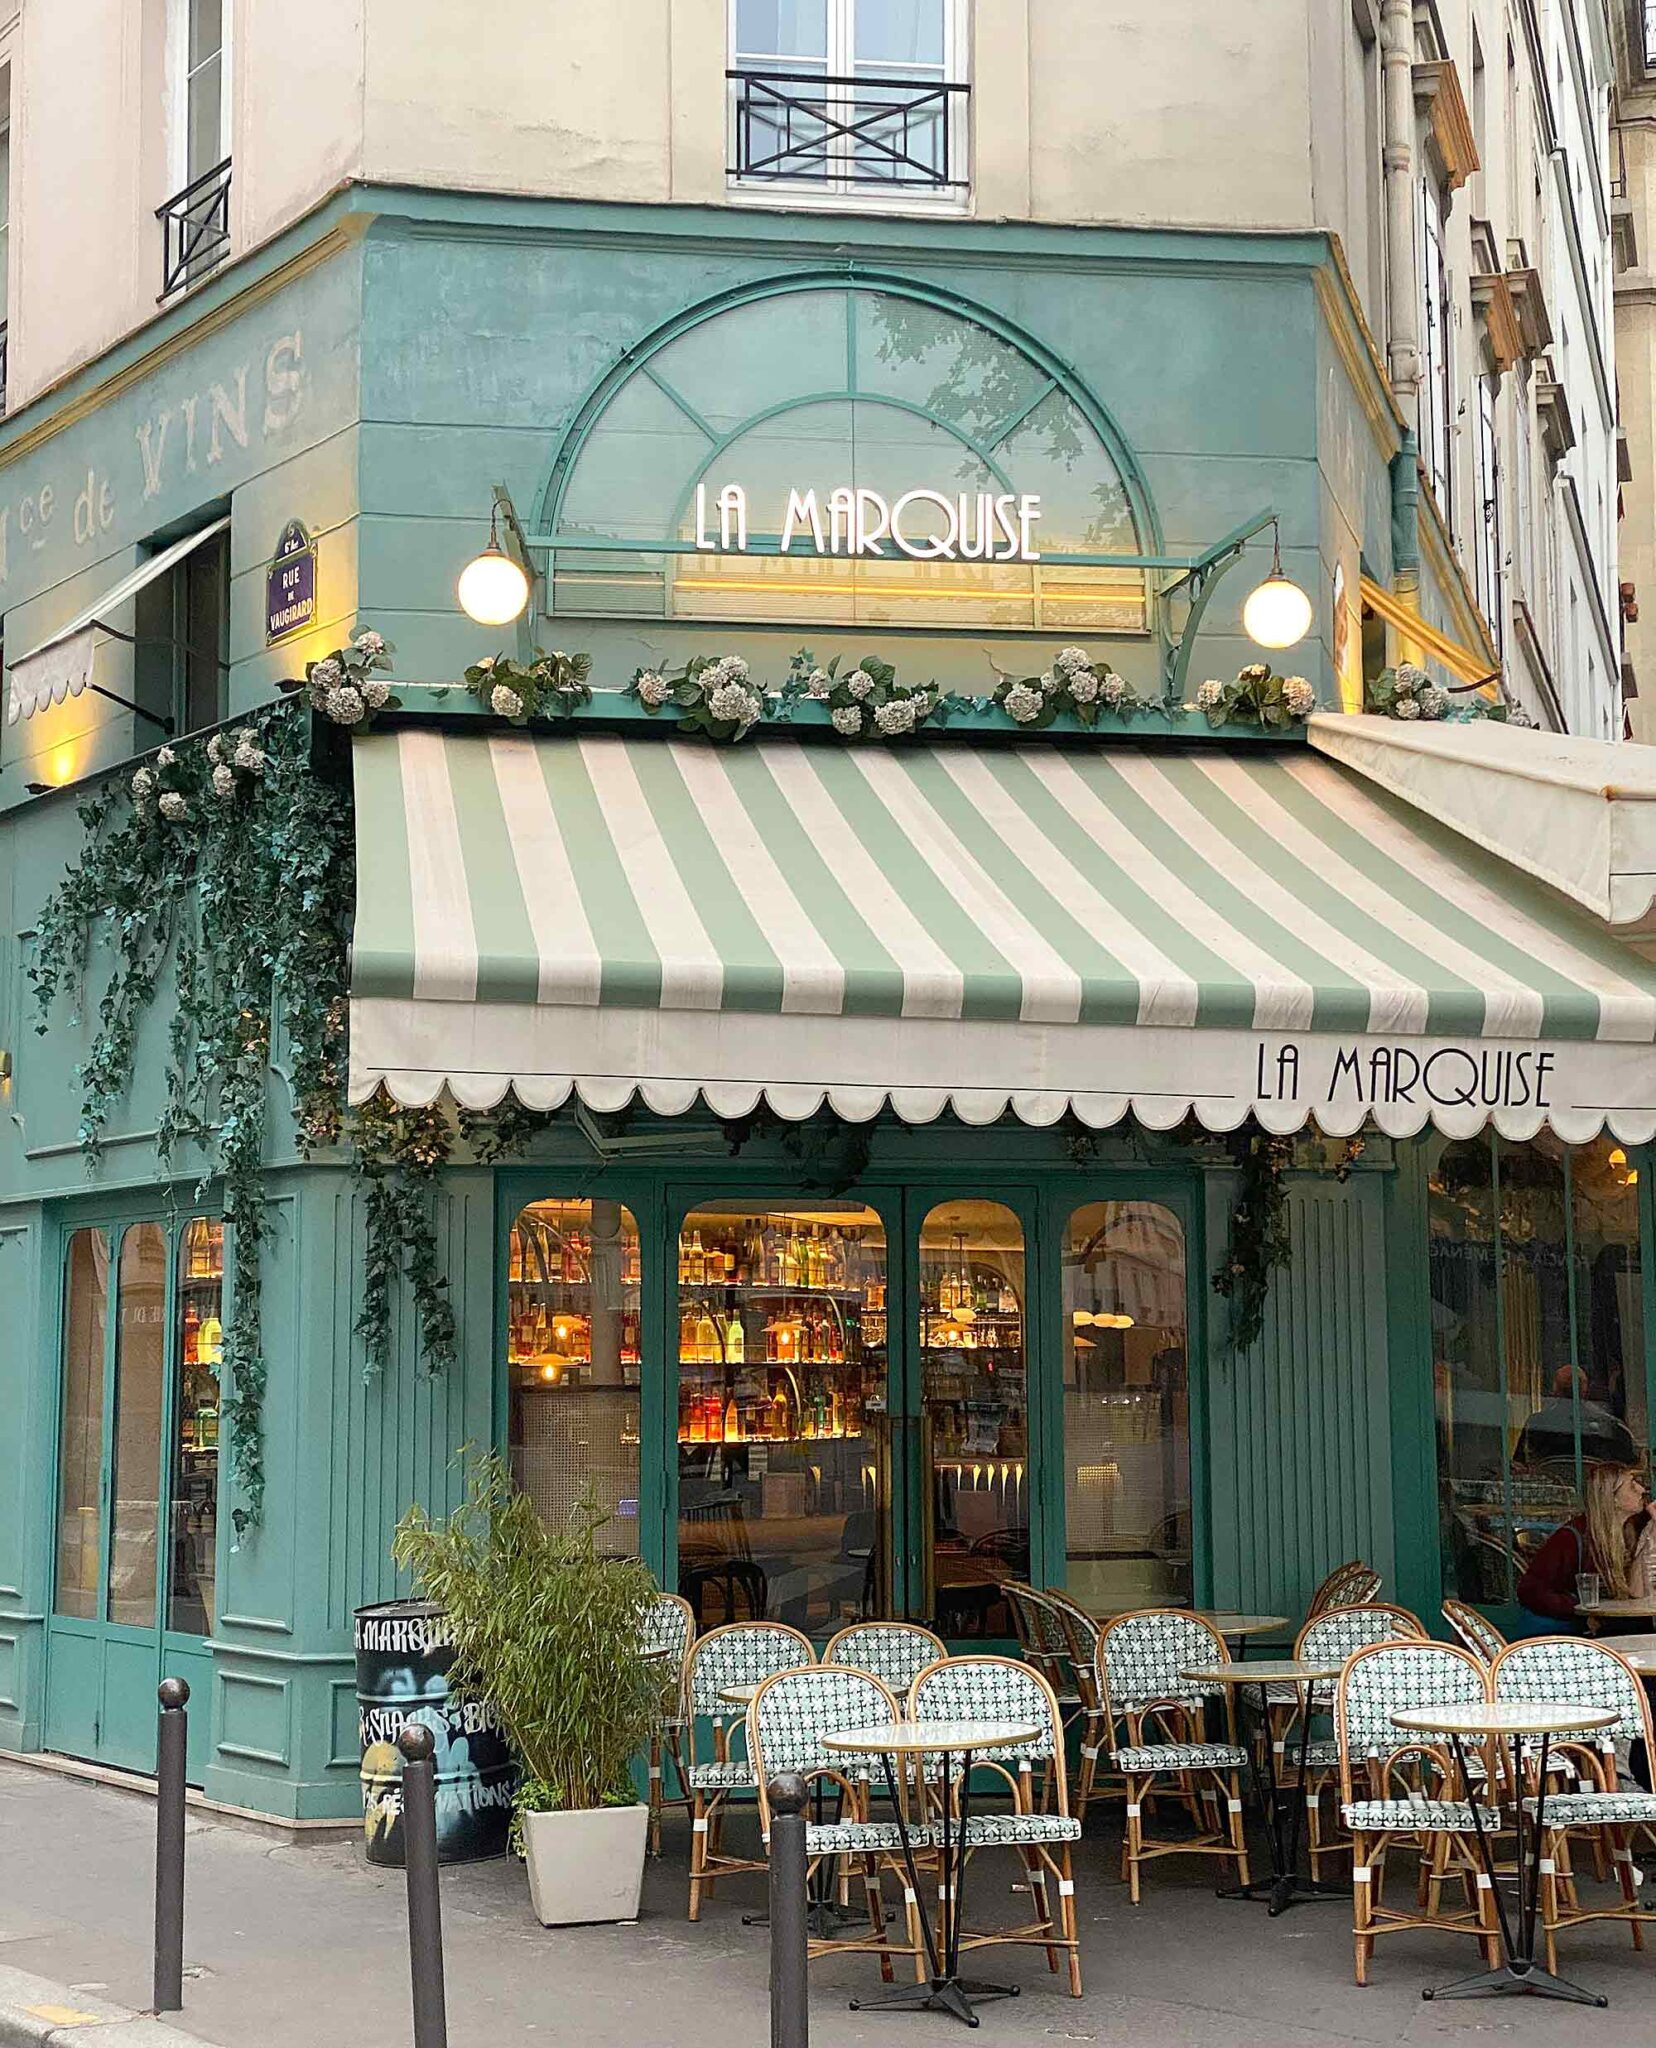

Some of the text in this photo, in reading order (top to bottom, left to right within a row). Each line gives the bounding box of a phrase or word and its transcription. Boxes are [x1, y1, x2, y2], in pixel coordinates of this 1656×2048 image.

[74, 467, 114, 544] de
[136, 330, 303, 498] VINS
[695, 483, 1041, 560] LA MARQUISE
[282, 566, 300, 590] RUE
[270, 597, 313, 631] VAUGIRARD
[1257, 1043, 1555, 1107] LA MARQUISE
